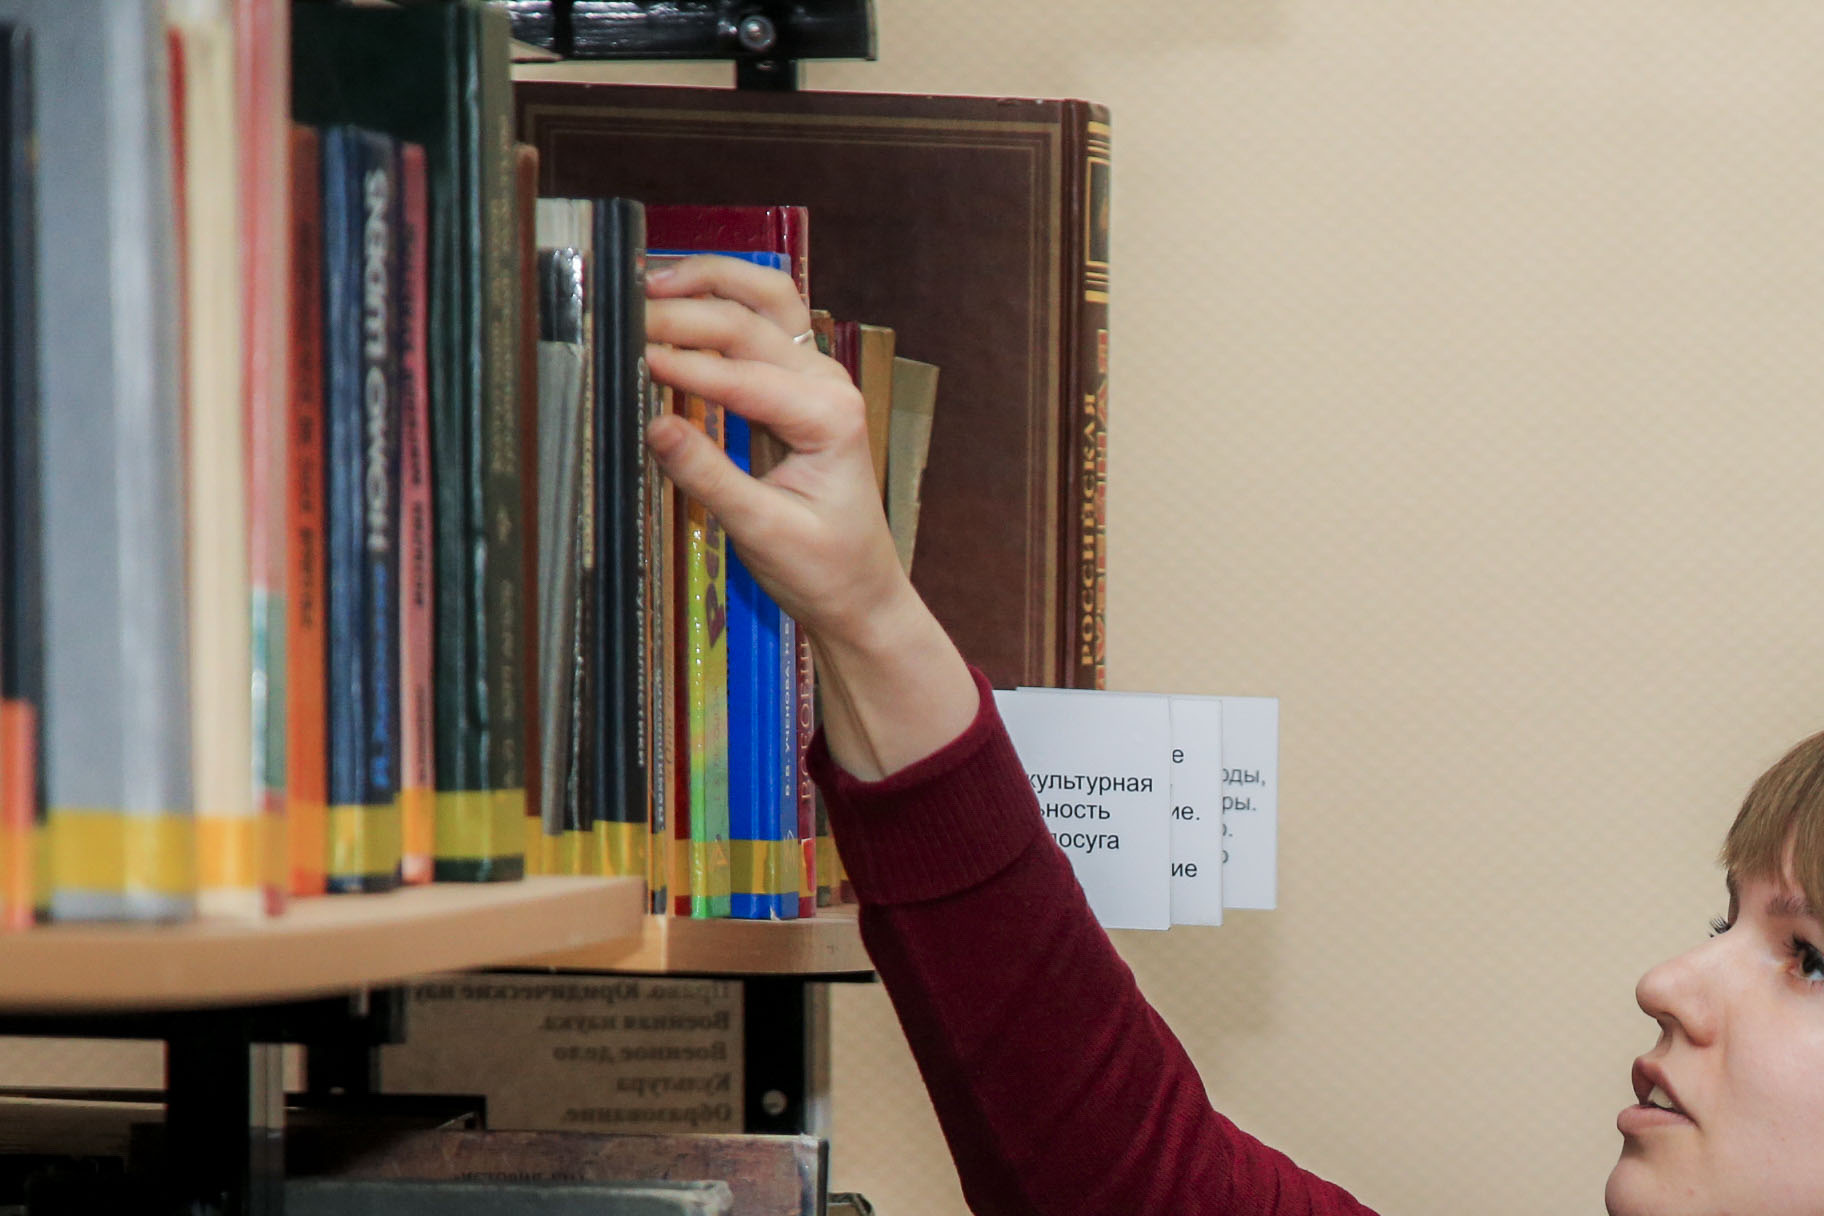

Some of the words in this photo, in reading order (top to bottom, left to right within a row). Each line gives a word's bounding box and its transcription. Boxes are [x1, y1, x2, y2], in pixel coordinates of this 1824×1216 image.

[363, 168, 389, 359] LUDENS
[365, 367, 388, 552] HOMO
[636, 356, 645, 466] Основы
[636, 476, 645, 567] теории
[1081, 391, 1095, 667] РОССИЙСКАЯ
[636, 576, 645, 765] журналистики
